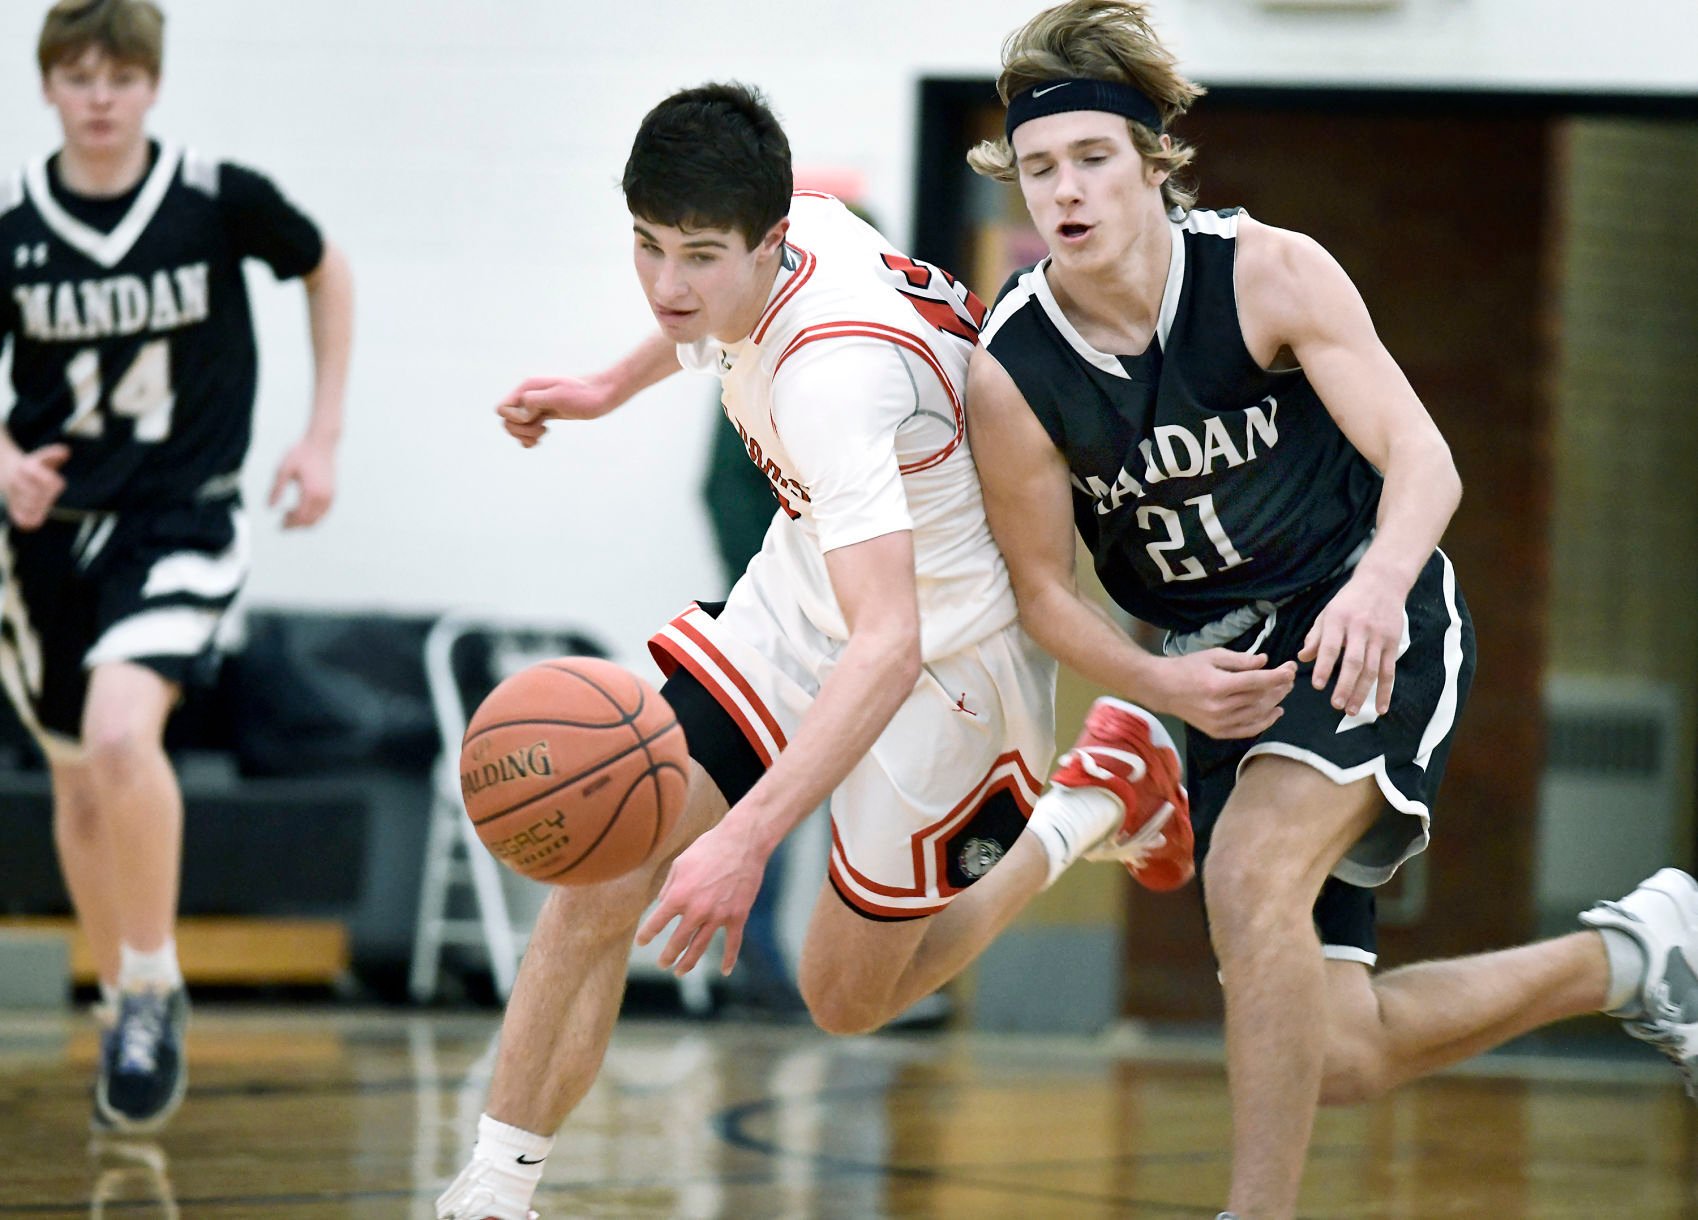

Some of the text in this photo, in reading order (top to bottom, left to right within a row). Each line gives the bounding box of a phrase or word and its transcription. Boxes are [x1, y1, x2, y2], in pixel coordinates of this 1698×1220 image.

[14, 262, 209, 341] MANDAN
[63, 338, 176, 441] 14
[1135, 493, 1254, 583] 21
[461, 742, 550, 798] ALDING
